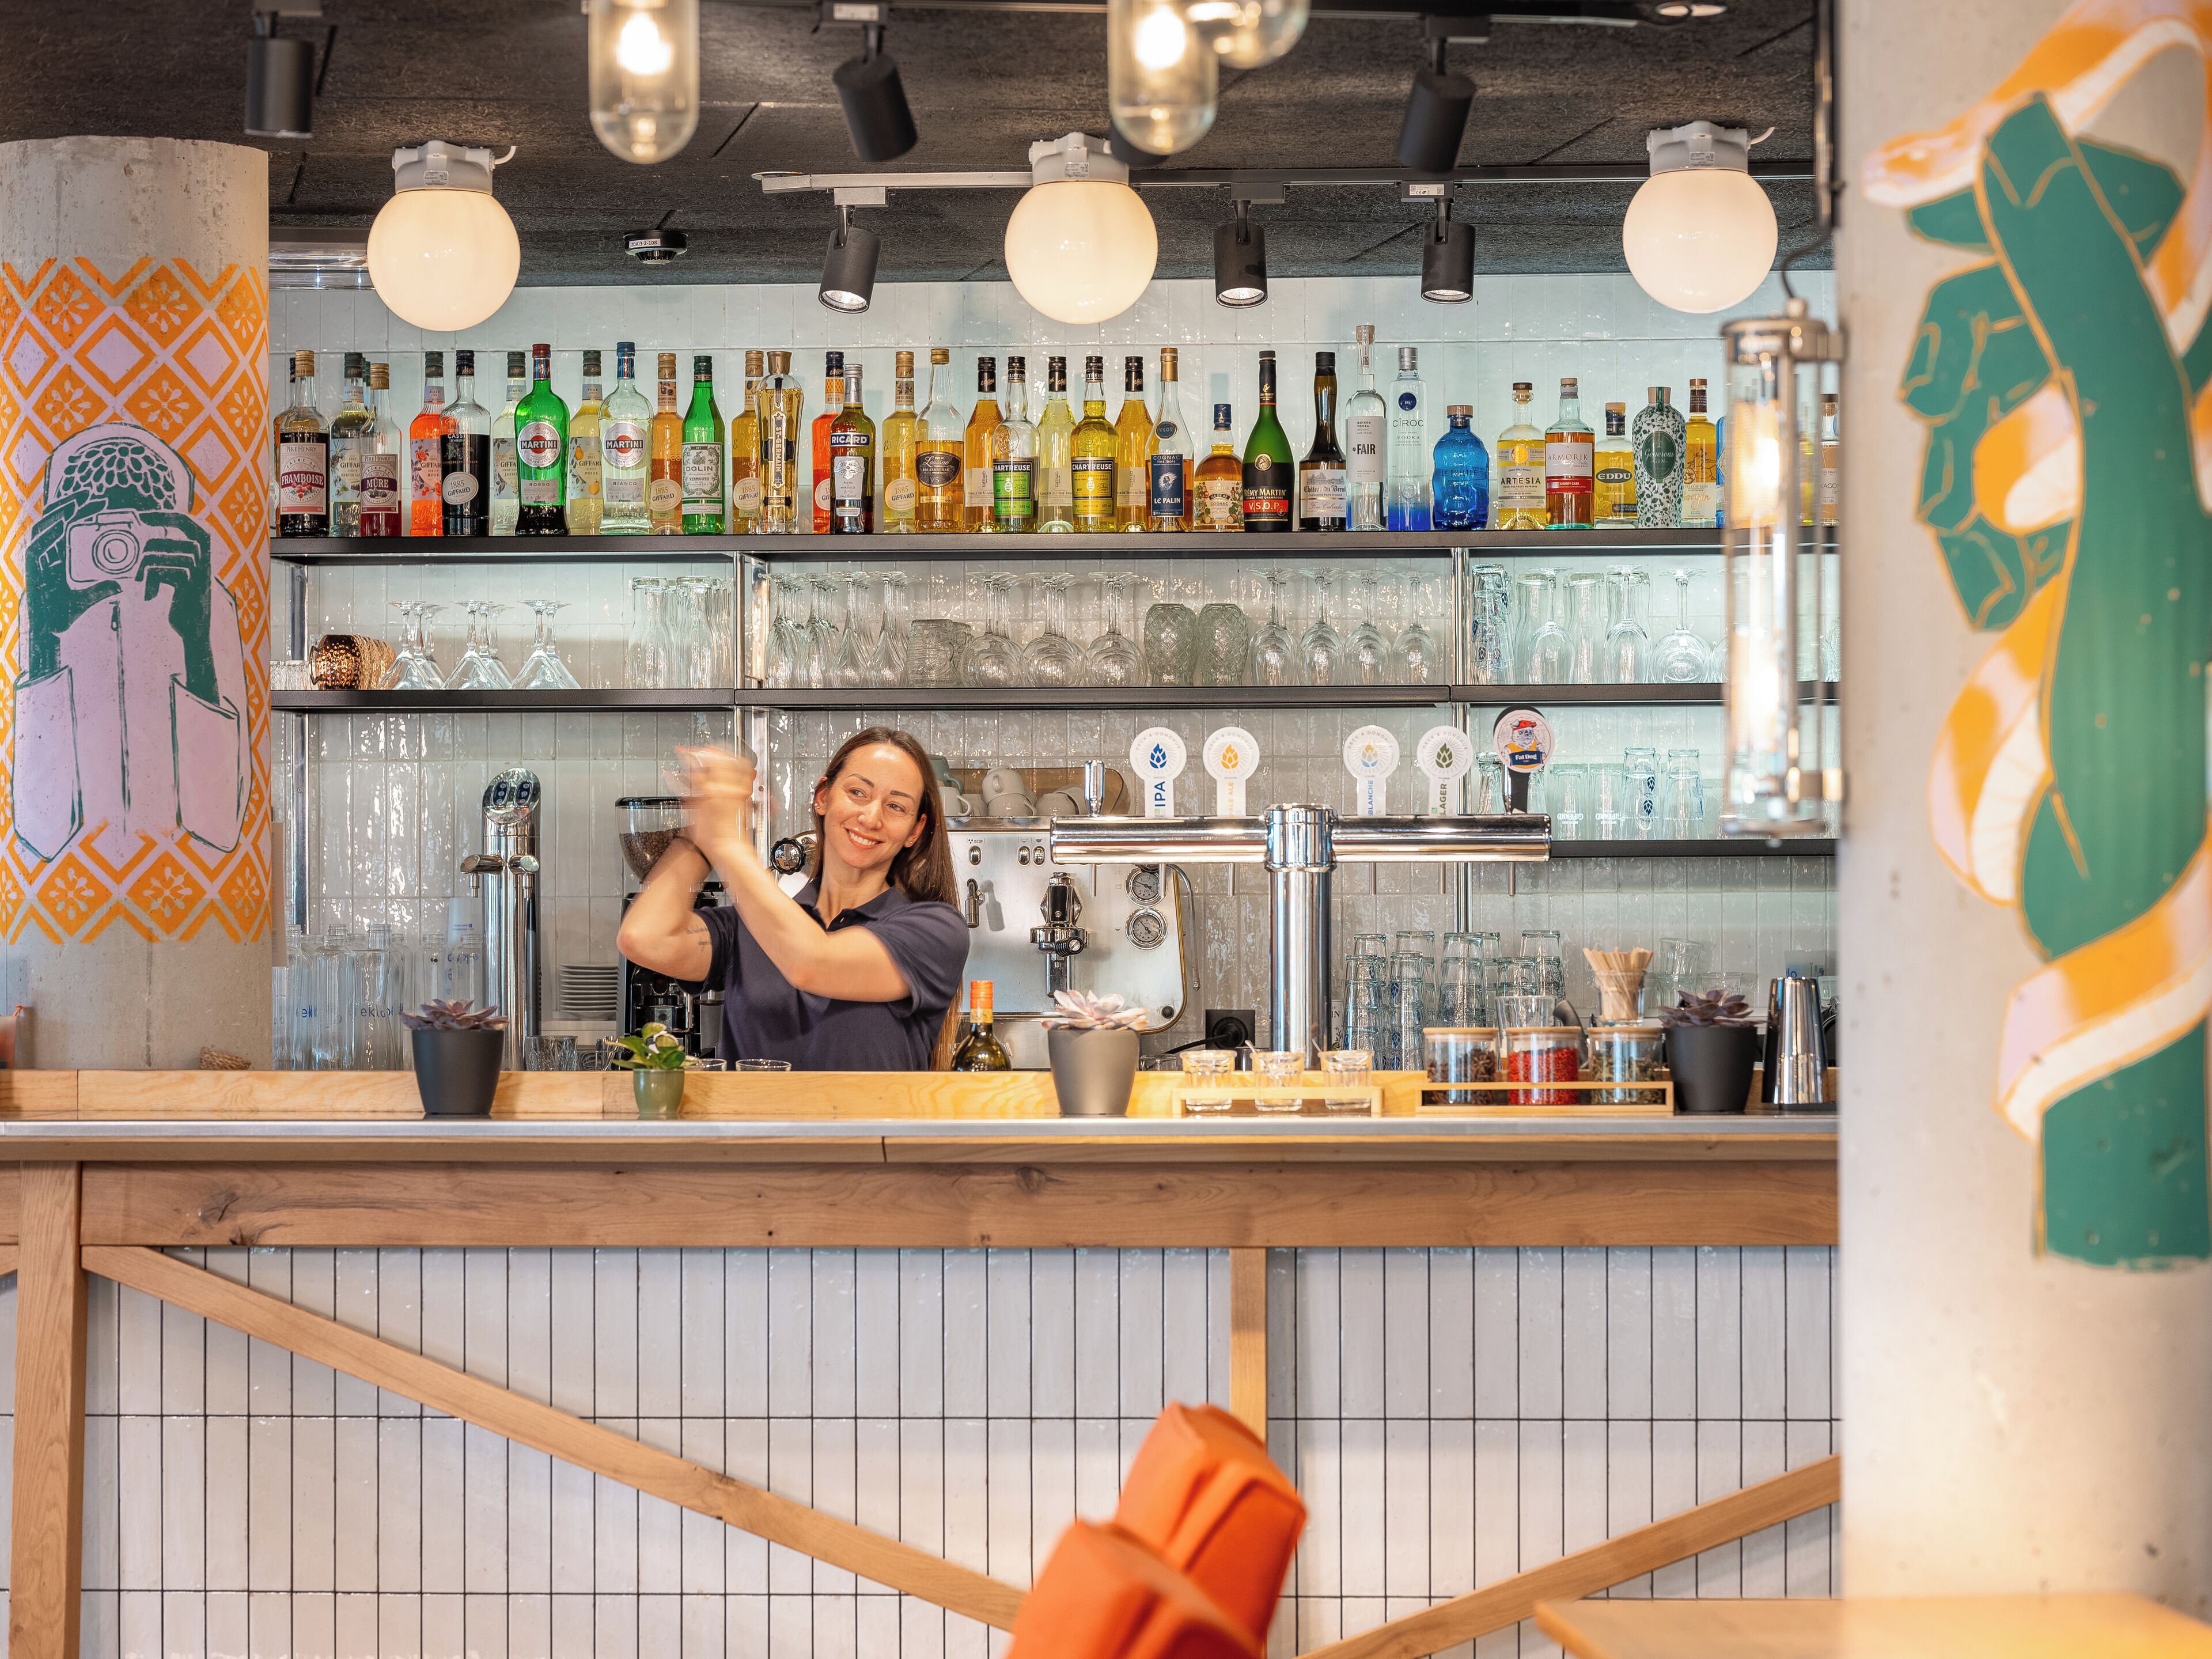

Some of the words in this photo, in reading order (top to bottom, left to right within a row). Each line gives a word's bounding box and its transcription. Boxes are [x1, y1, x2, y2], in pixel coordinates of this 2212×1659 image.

[1392, 418, 1424, 427] CÎROC
[831, 435, 867, 444] RICARD
[521, 441, 556, 449] MARTINI
[1357, 444, 1376, 454] FAIR
[1645, 449, 1675, 459] Generous
[282, 474, 324, 486] FRAMBOISE
[366, 478, 389, 488] MÛRE
[450, 480, 465, 490] 1885
[655, 486, 668, 495] 1885
[742, 485, 755, 494] 1885
[895, 486, 908, 494] 1885
[1259, 488, 1285, 497] MARTIN
[1136, 737, 1147, 751] DECK
[1155, 732, 1181, 749] DONOHUE
[1207, 737, 1219, 751] DECK
[1228, 732, 1253, 750] DONOHUE
[1347, 735, 1358, 749] DECK
[1423, 735, 1434, 749] DECK
[1443, 732, 1468, 750] DONOHUE
[1154, 781, 1165, 807] IPA
[361, 1005, 385, 1018] eklo
